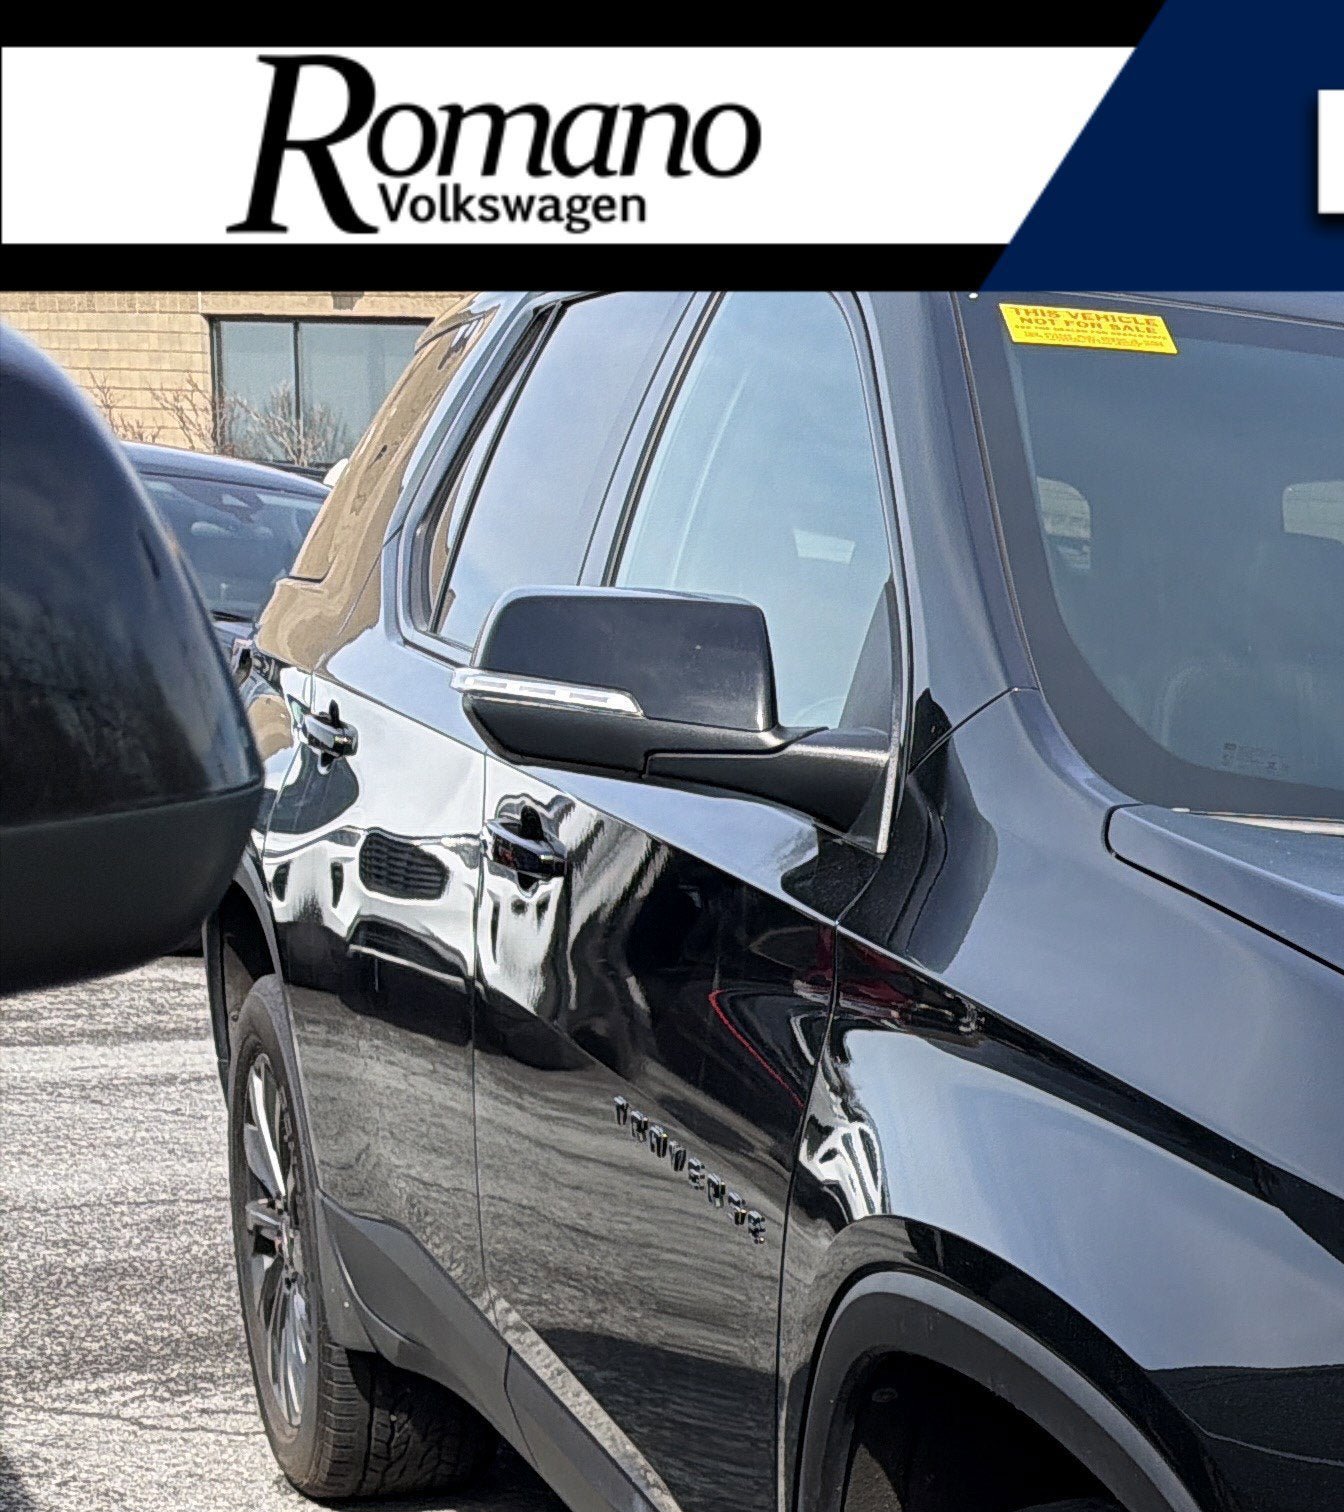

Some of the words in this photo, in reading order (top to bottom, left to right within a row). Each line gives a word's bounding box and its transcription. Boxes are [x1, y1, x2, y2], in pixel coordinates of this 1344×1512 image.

[1010, 307, 1061, 319] THIS
[1065, 311, 1159, 328] VEHICLE
[1020, 317, 1057, 326] NOT
[1064, 319, 1103, 330] FOR
[1110, 323, 1158, 334] SALE
